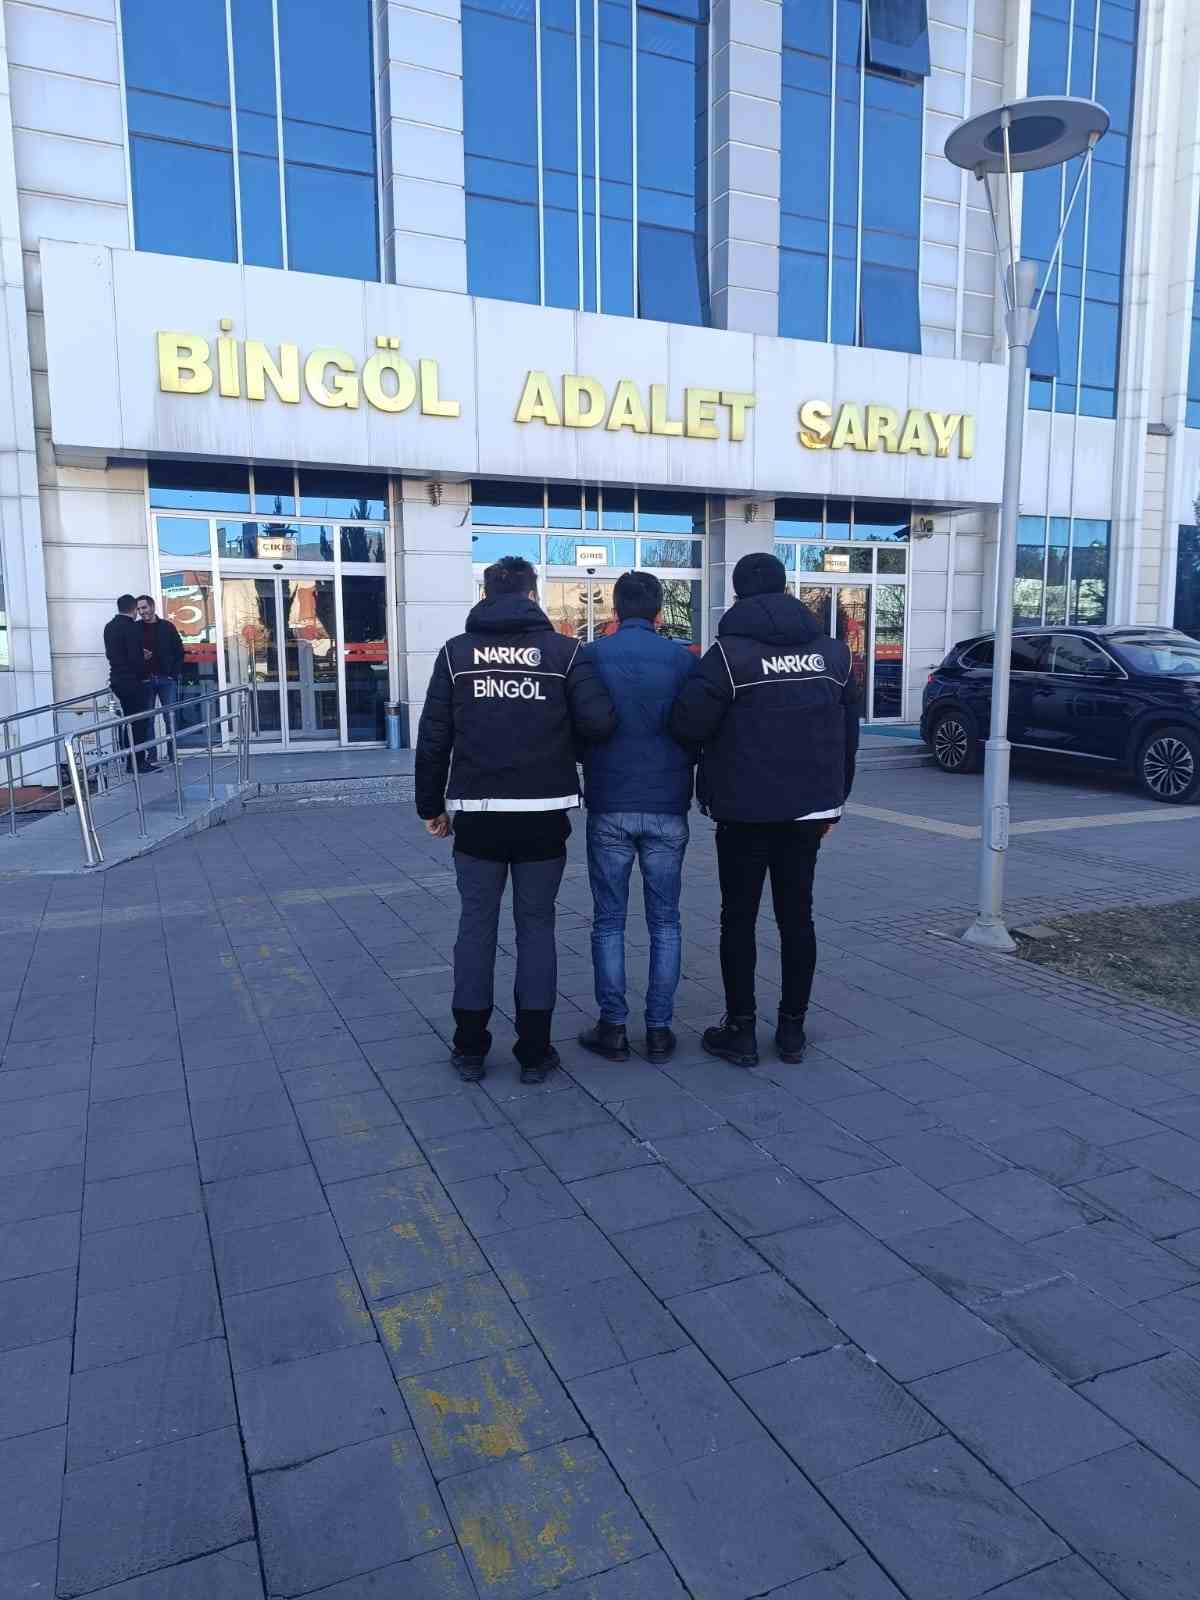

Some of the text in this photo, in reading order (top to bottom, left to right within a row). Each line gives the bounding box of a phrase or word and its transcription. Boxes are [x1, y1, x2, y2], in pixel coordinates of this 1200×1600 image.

[157, 318, 975, 459] BİNGÖL ADALET SARAYI
[473, 675, 546, 700] BİNGÖL
